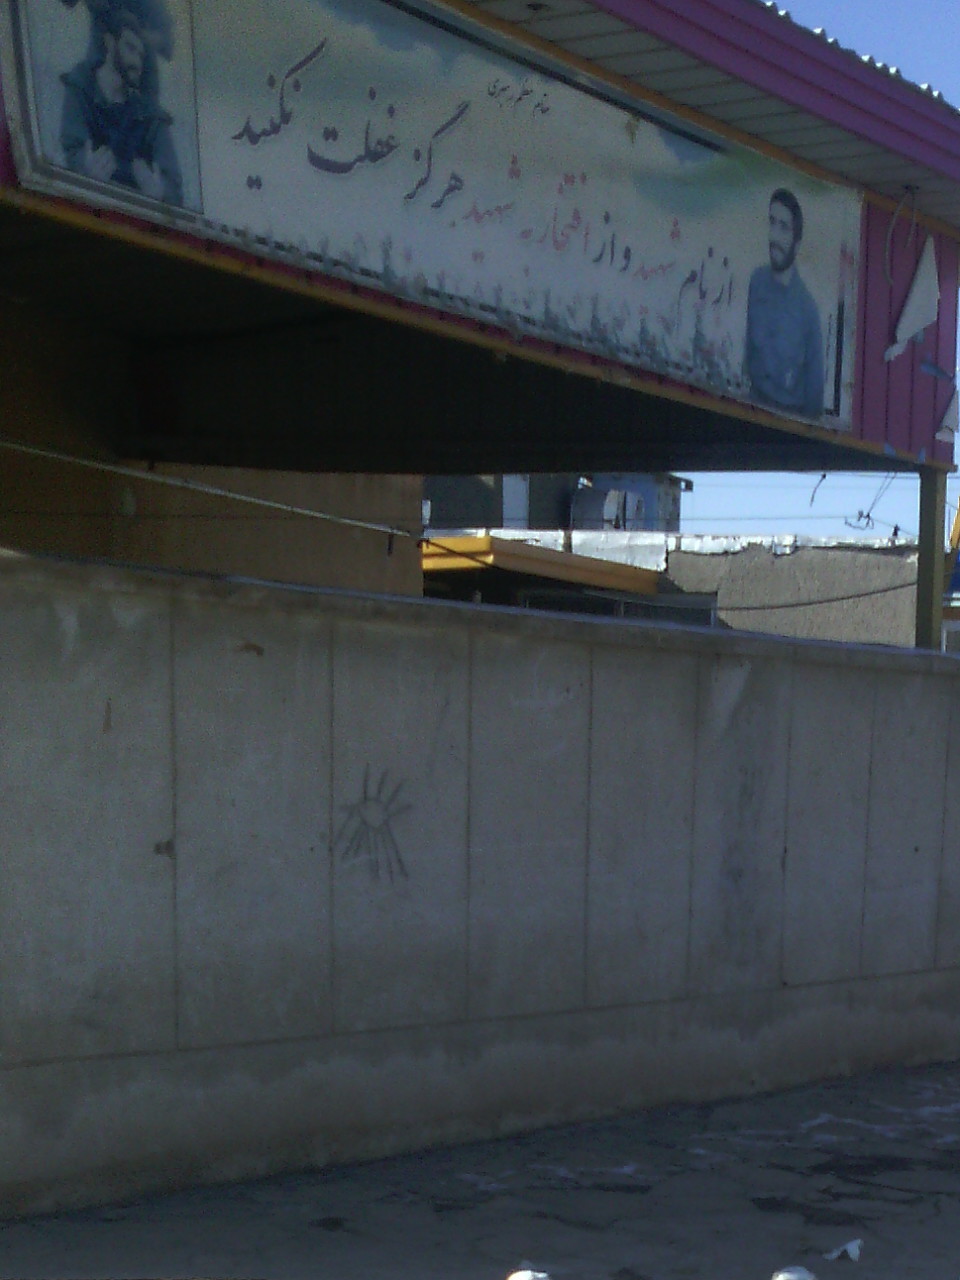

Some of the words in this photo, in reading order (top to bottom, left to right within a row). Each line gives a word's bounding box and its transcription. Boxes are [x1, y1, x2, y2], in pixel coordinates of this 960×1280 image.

[231, 37, 328, 191] نکنید
[306, 87, 401, 175] غفلت
[403, 100, 471, 209] هرگز
